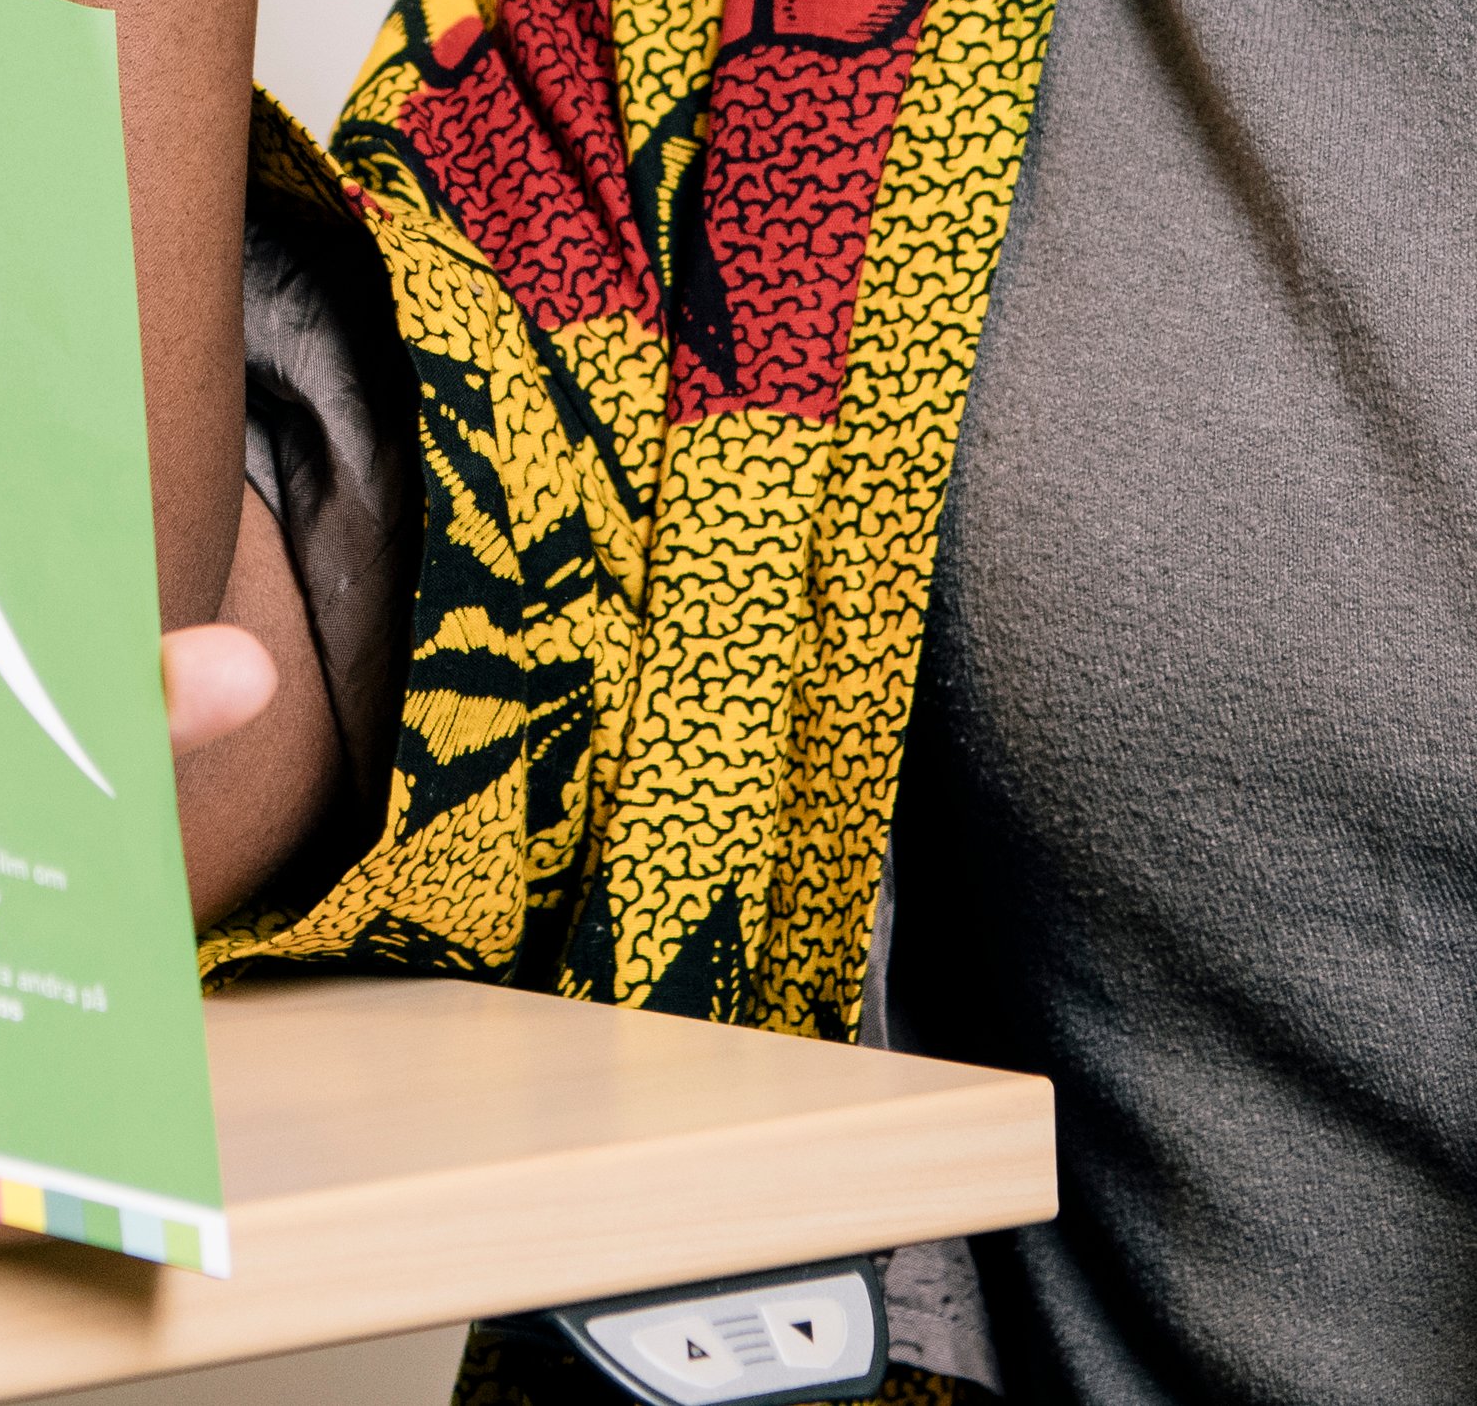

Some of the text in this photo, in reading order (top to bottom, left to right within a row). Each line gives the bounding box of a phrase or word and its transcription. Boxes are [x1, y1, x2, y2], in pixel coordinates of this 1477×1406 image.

[32, 863, 68, 892] om
[16, 970, 78, 1006] andra
[80, 982, 108, 1013] på
